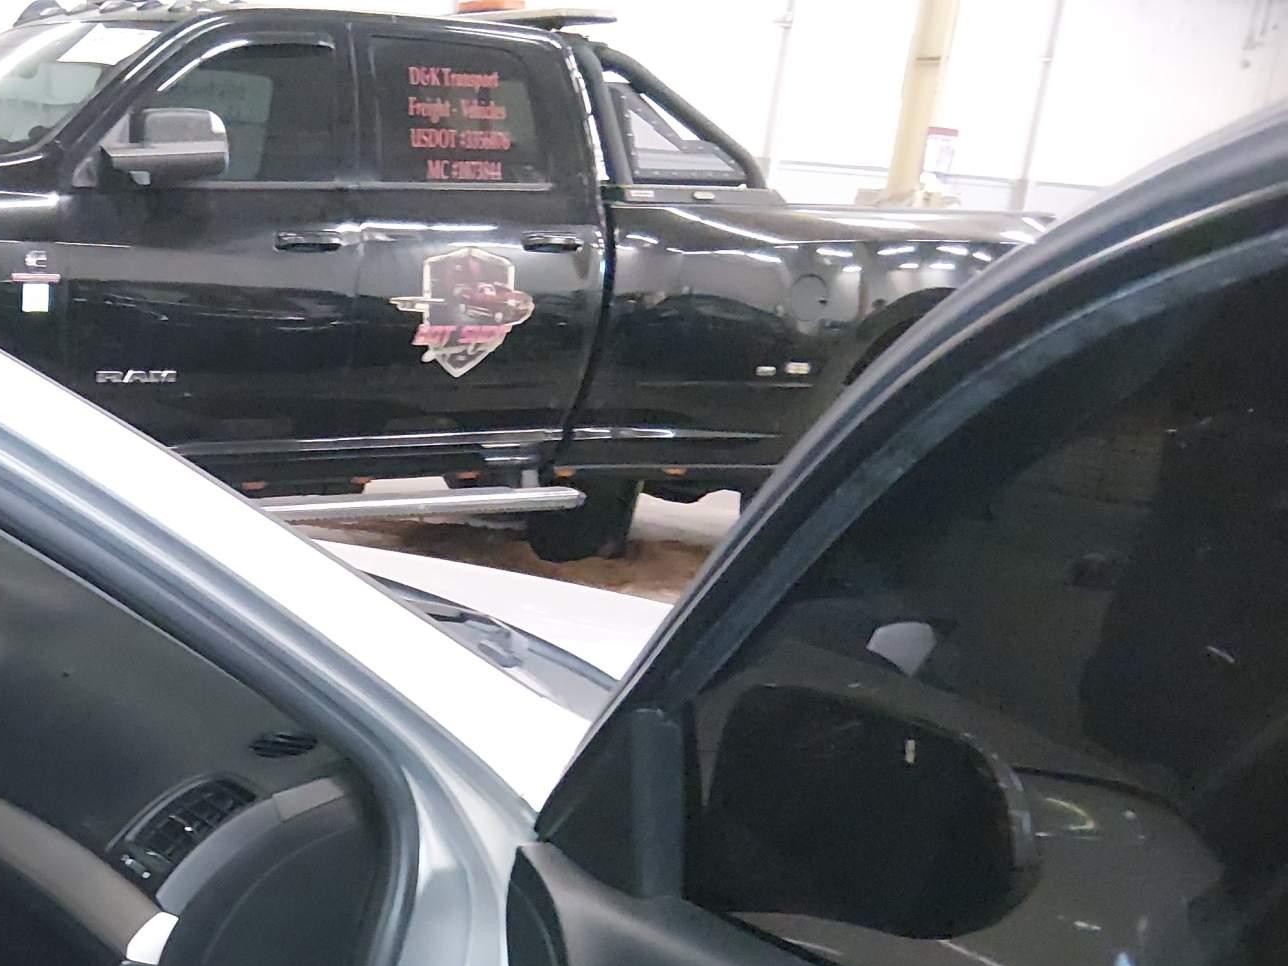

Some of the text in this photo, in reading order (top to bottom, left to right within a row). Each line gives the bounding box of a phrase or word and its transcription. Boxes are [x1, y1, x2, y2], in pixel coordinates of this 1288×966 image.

[408, 66, 499, 92] D&K Transport
[408, 97, 450, 123] Freight
[459, 99, 507, 120] Vehicles
[410, 128, 457, 148] USDOT
[427, 159, 450, 179] MC
[95, 369, 177, 383] RAM
